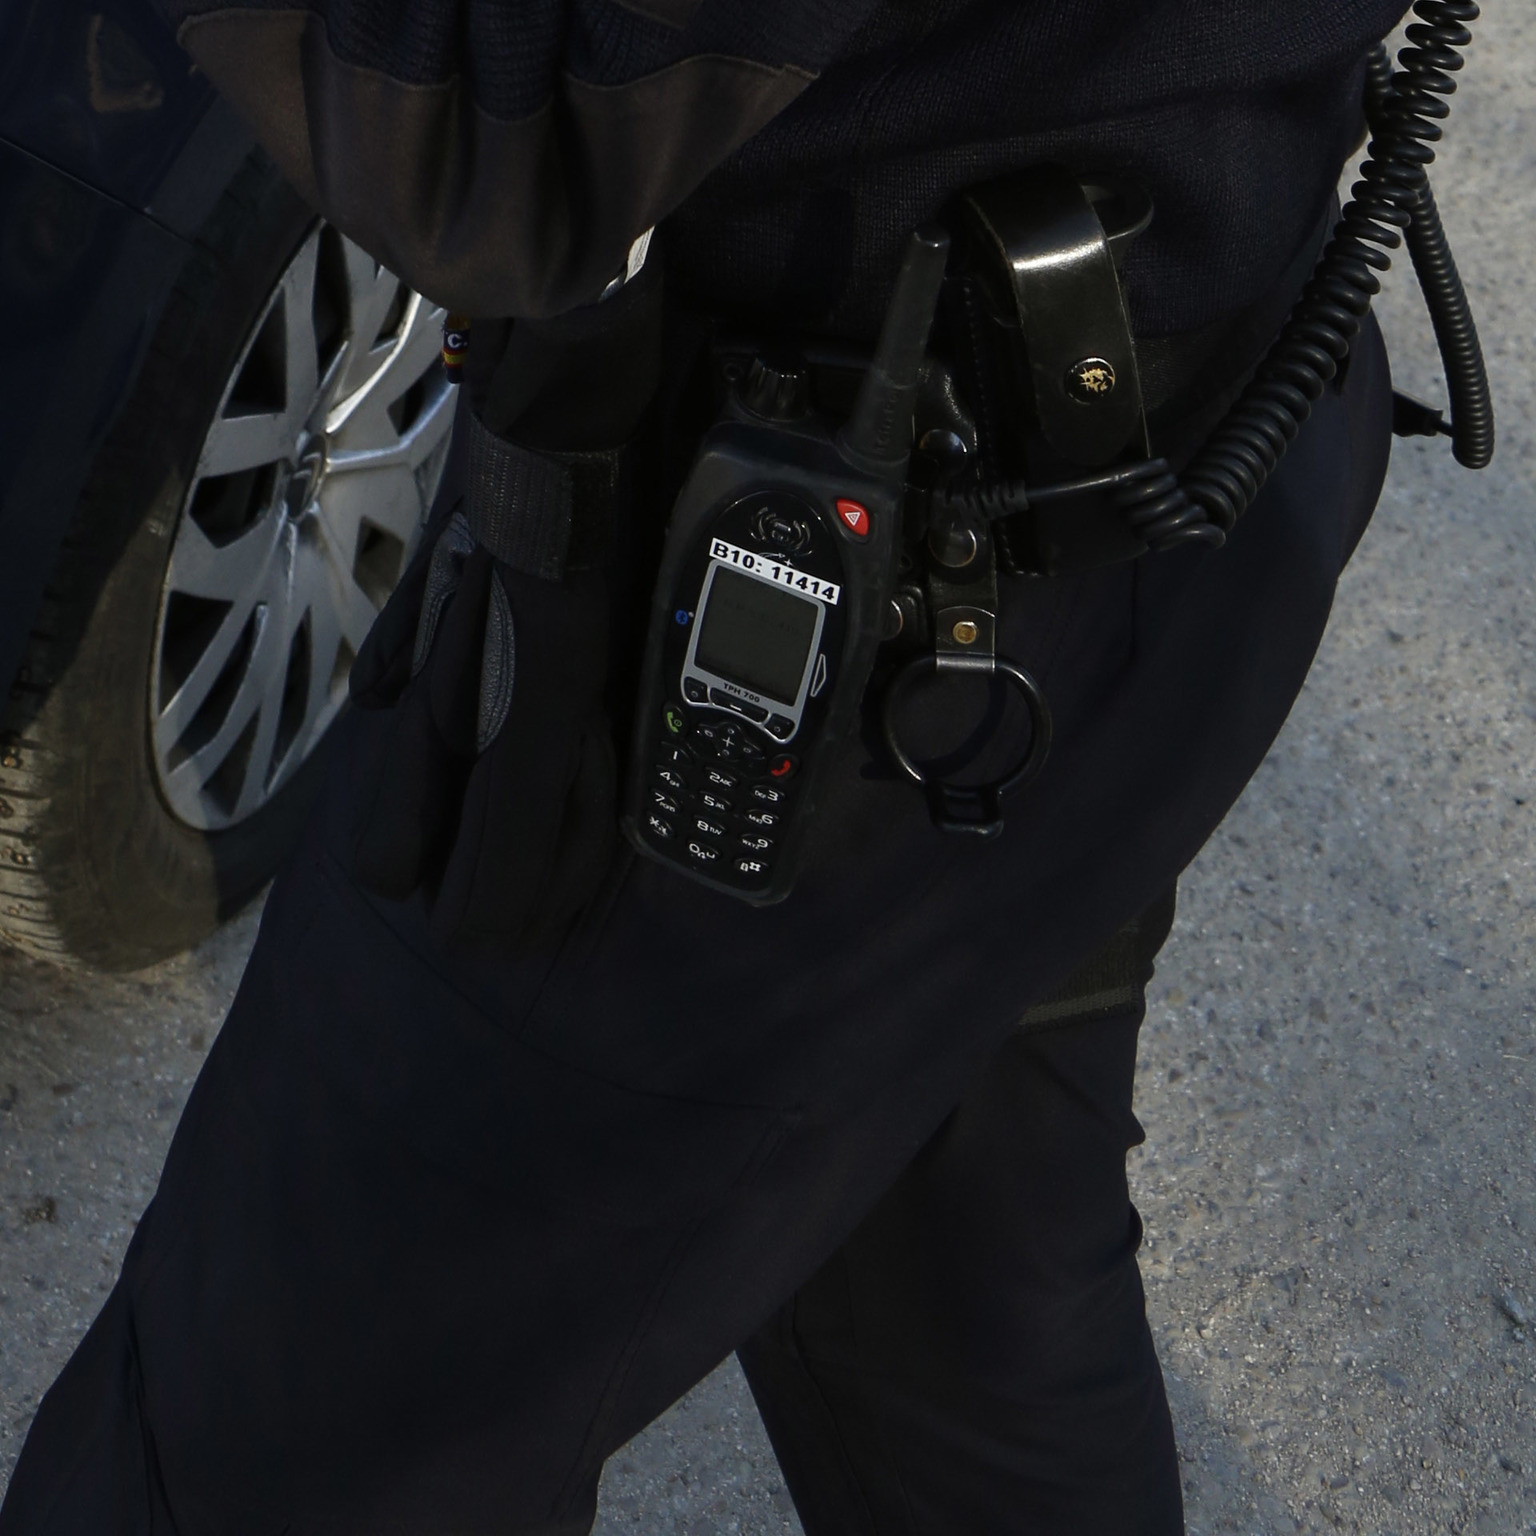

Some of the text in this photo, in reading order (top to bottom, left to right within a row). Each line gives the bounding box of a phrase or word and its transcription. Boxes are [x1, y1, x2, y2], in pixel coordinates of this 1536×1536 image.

[713, 543, 835, 600] B10: 11414
[723, 682, 761, 704] TPH 700
[660, 771, 671, 781] 4
[709, 771, 721, 783] 2
[655, 792, 666, 803] 7
[703, 795, 715, 807] 5
[767, 789, 779, 802] 3
[762, 814, 774, 825] 6
[697, 820, 709, 832] 8
[757, 838, 768, 848] 9
